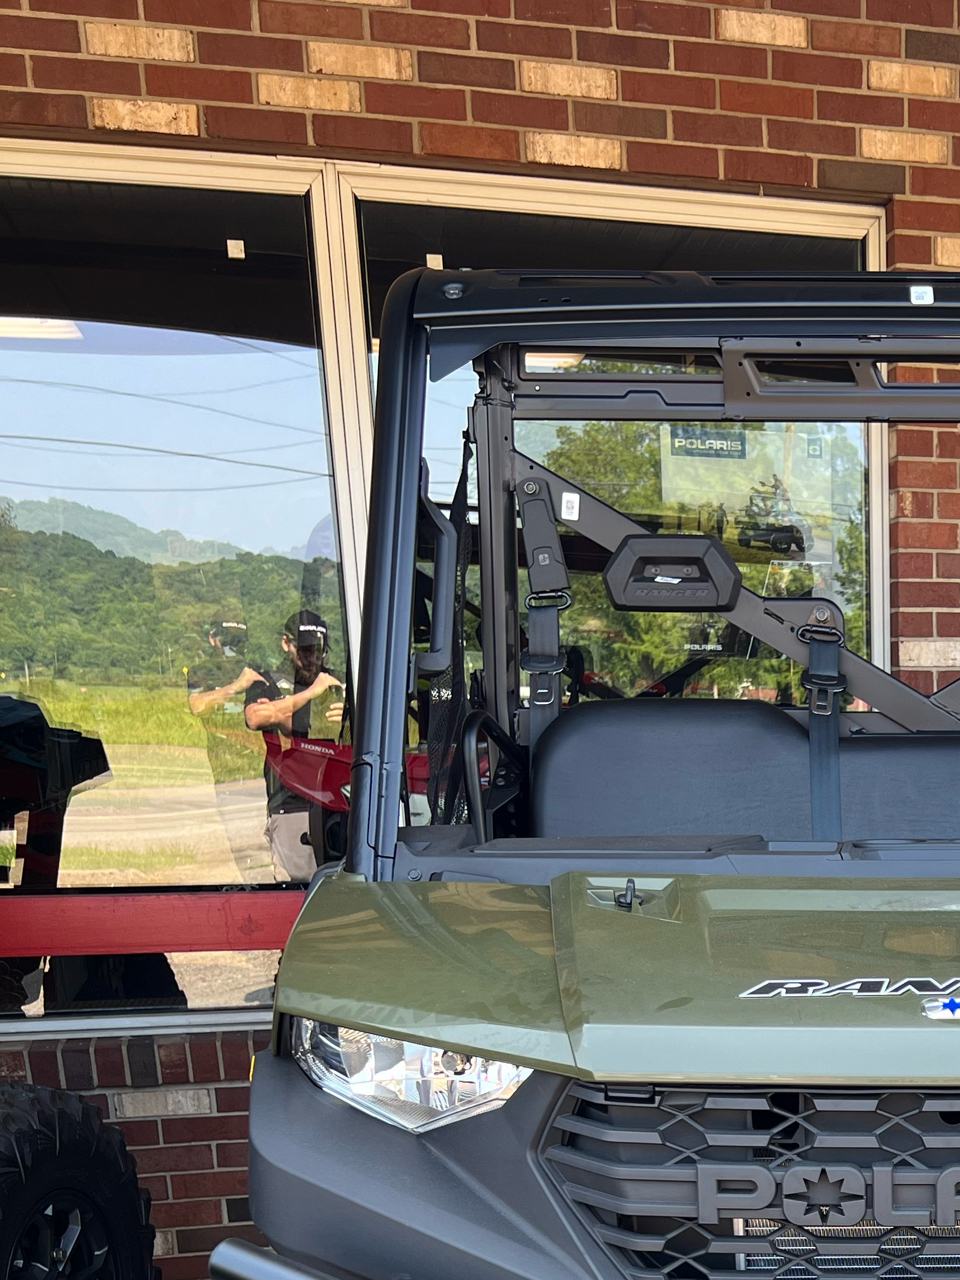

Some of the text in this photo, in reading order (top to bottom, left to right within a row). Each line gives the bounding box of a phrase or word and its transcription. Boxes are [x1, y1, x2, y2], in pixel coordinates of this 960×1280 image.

[674, 438, 742, 451] POLARIS
[633, 588, 710, 598] RANGER
[684, 643, 722, 651] POLARIS
[300, 742, 335, 755] HONDA
